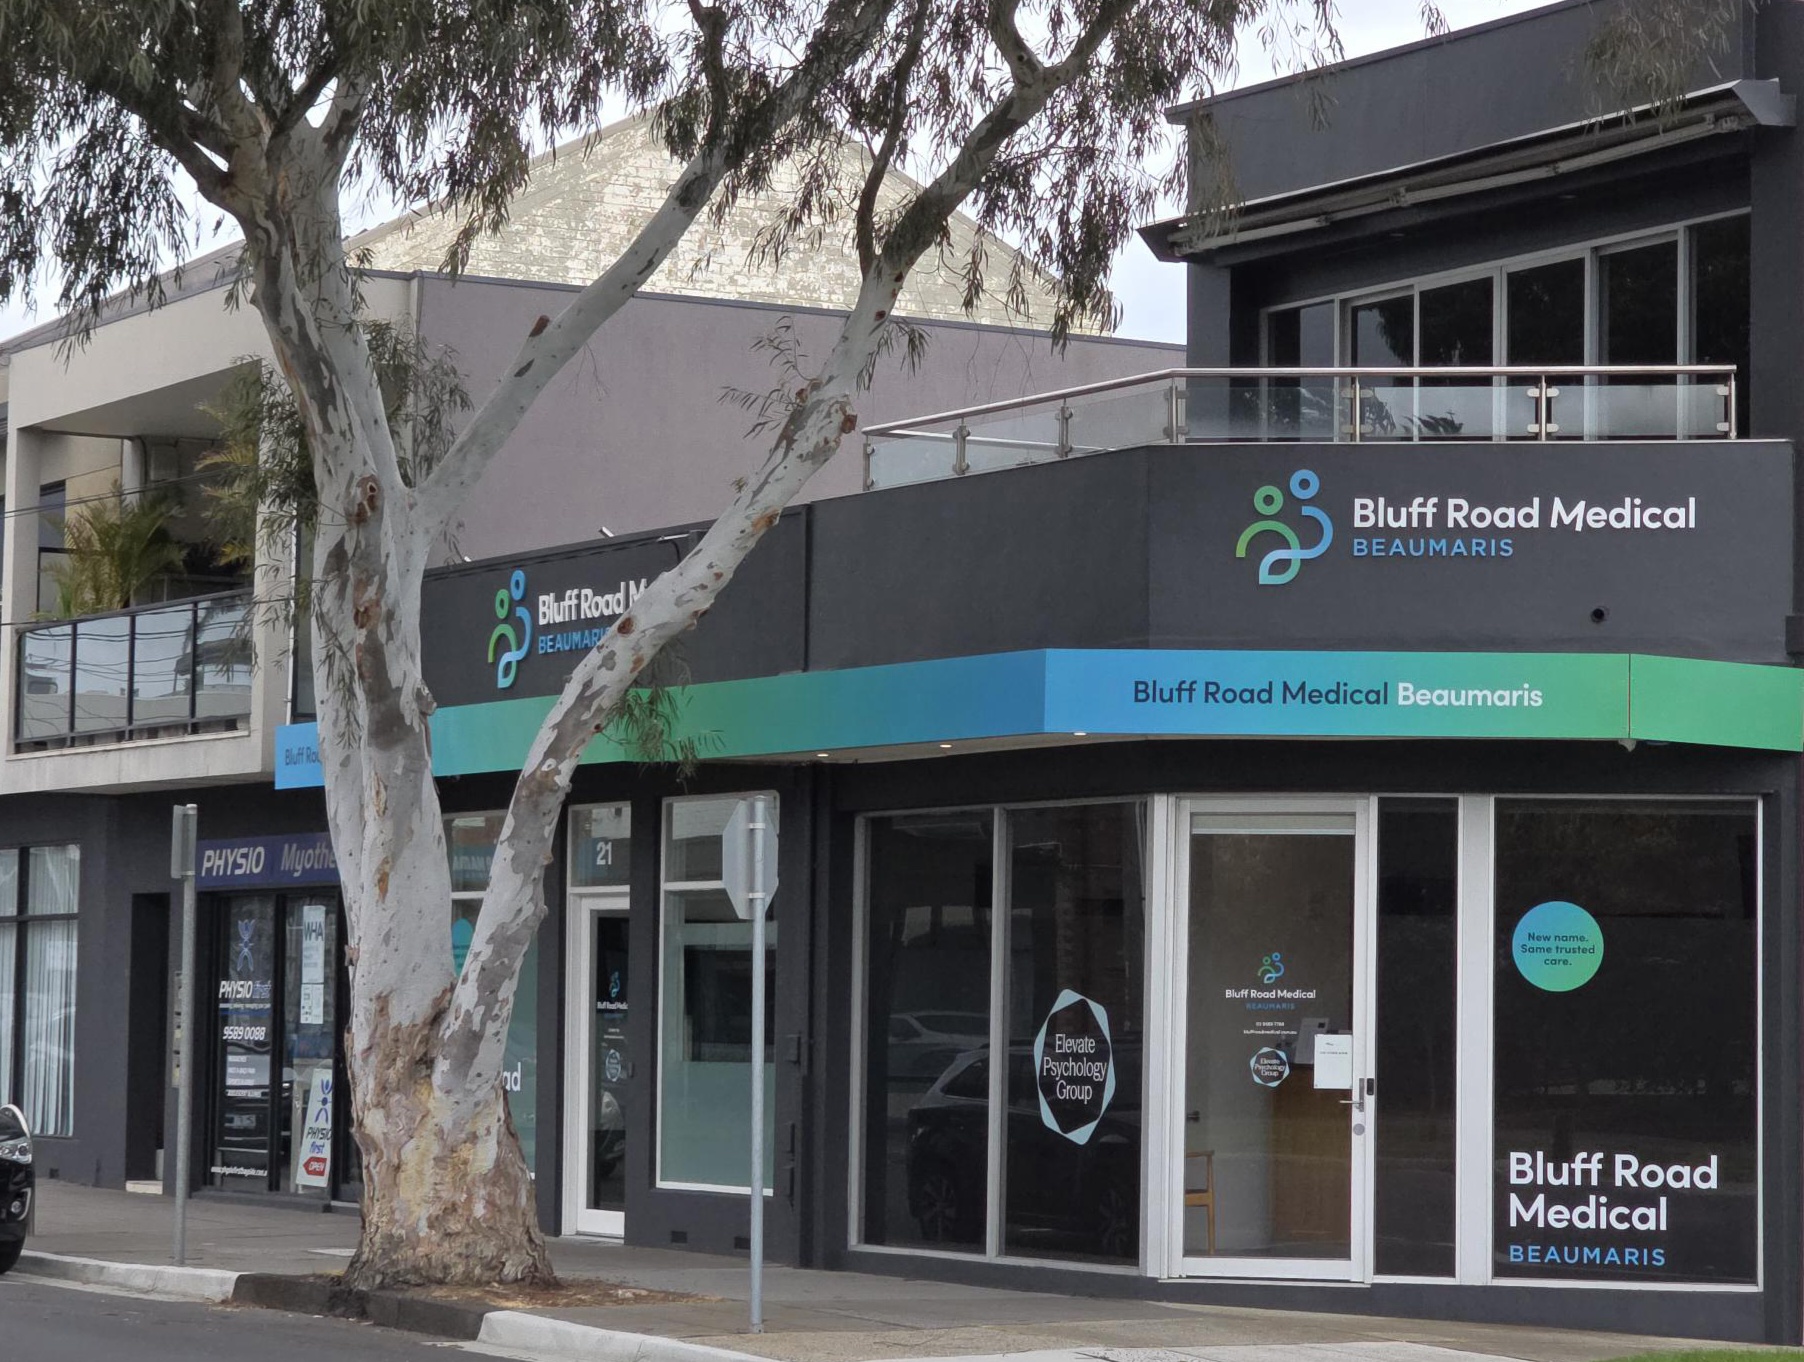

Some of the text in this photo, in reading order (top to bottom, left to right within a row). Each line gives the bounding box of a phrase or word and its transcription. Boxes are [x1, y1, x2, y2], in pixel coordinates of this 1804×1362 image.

[1353, 496, 1696, 532] Bluff Road Medical
[1353, 538, 1514, 557] BEAUMARIS
[538, 588, 580, 626] Bluff
[580, 581, 626, 619] Road
[1133, 679, 1543, 707] Bluff Road Medical Beaumaris
[285, 746, 319, 767] Bluff Ro
[201, 843, 336, 877] PHYSIO Myothe
[596, 841, 612, 865] 21
[1528, 932, 1589, 943] New name.
[1520, 944, 1596, 955] Same trusted
[1543, 958, 1573, 966] care.
[218, 980, 253, 998] PHYSIO
[1225, 988, 1316, 999] Bluff Road Medical
[222, 1026, 267, 1041] 9589 0088
[1055, 1033, 1096, 1054] Elevate
[503, 1061, 522, 1092] ad
[1043, 1056, 1107, 1082] Psychology
[1056, 1080, 1093, 1105] Group
[309, 1161, 324, 1171] OPEN
[1509, 1150, 1718, 1190] Bluff Road
[1509, 1192, 1668, 1231] Medical
[1509, 1245, 1667, 1267] BEAUMARIS
